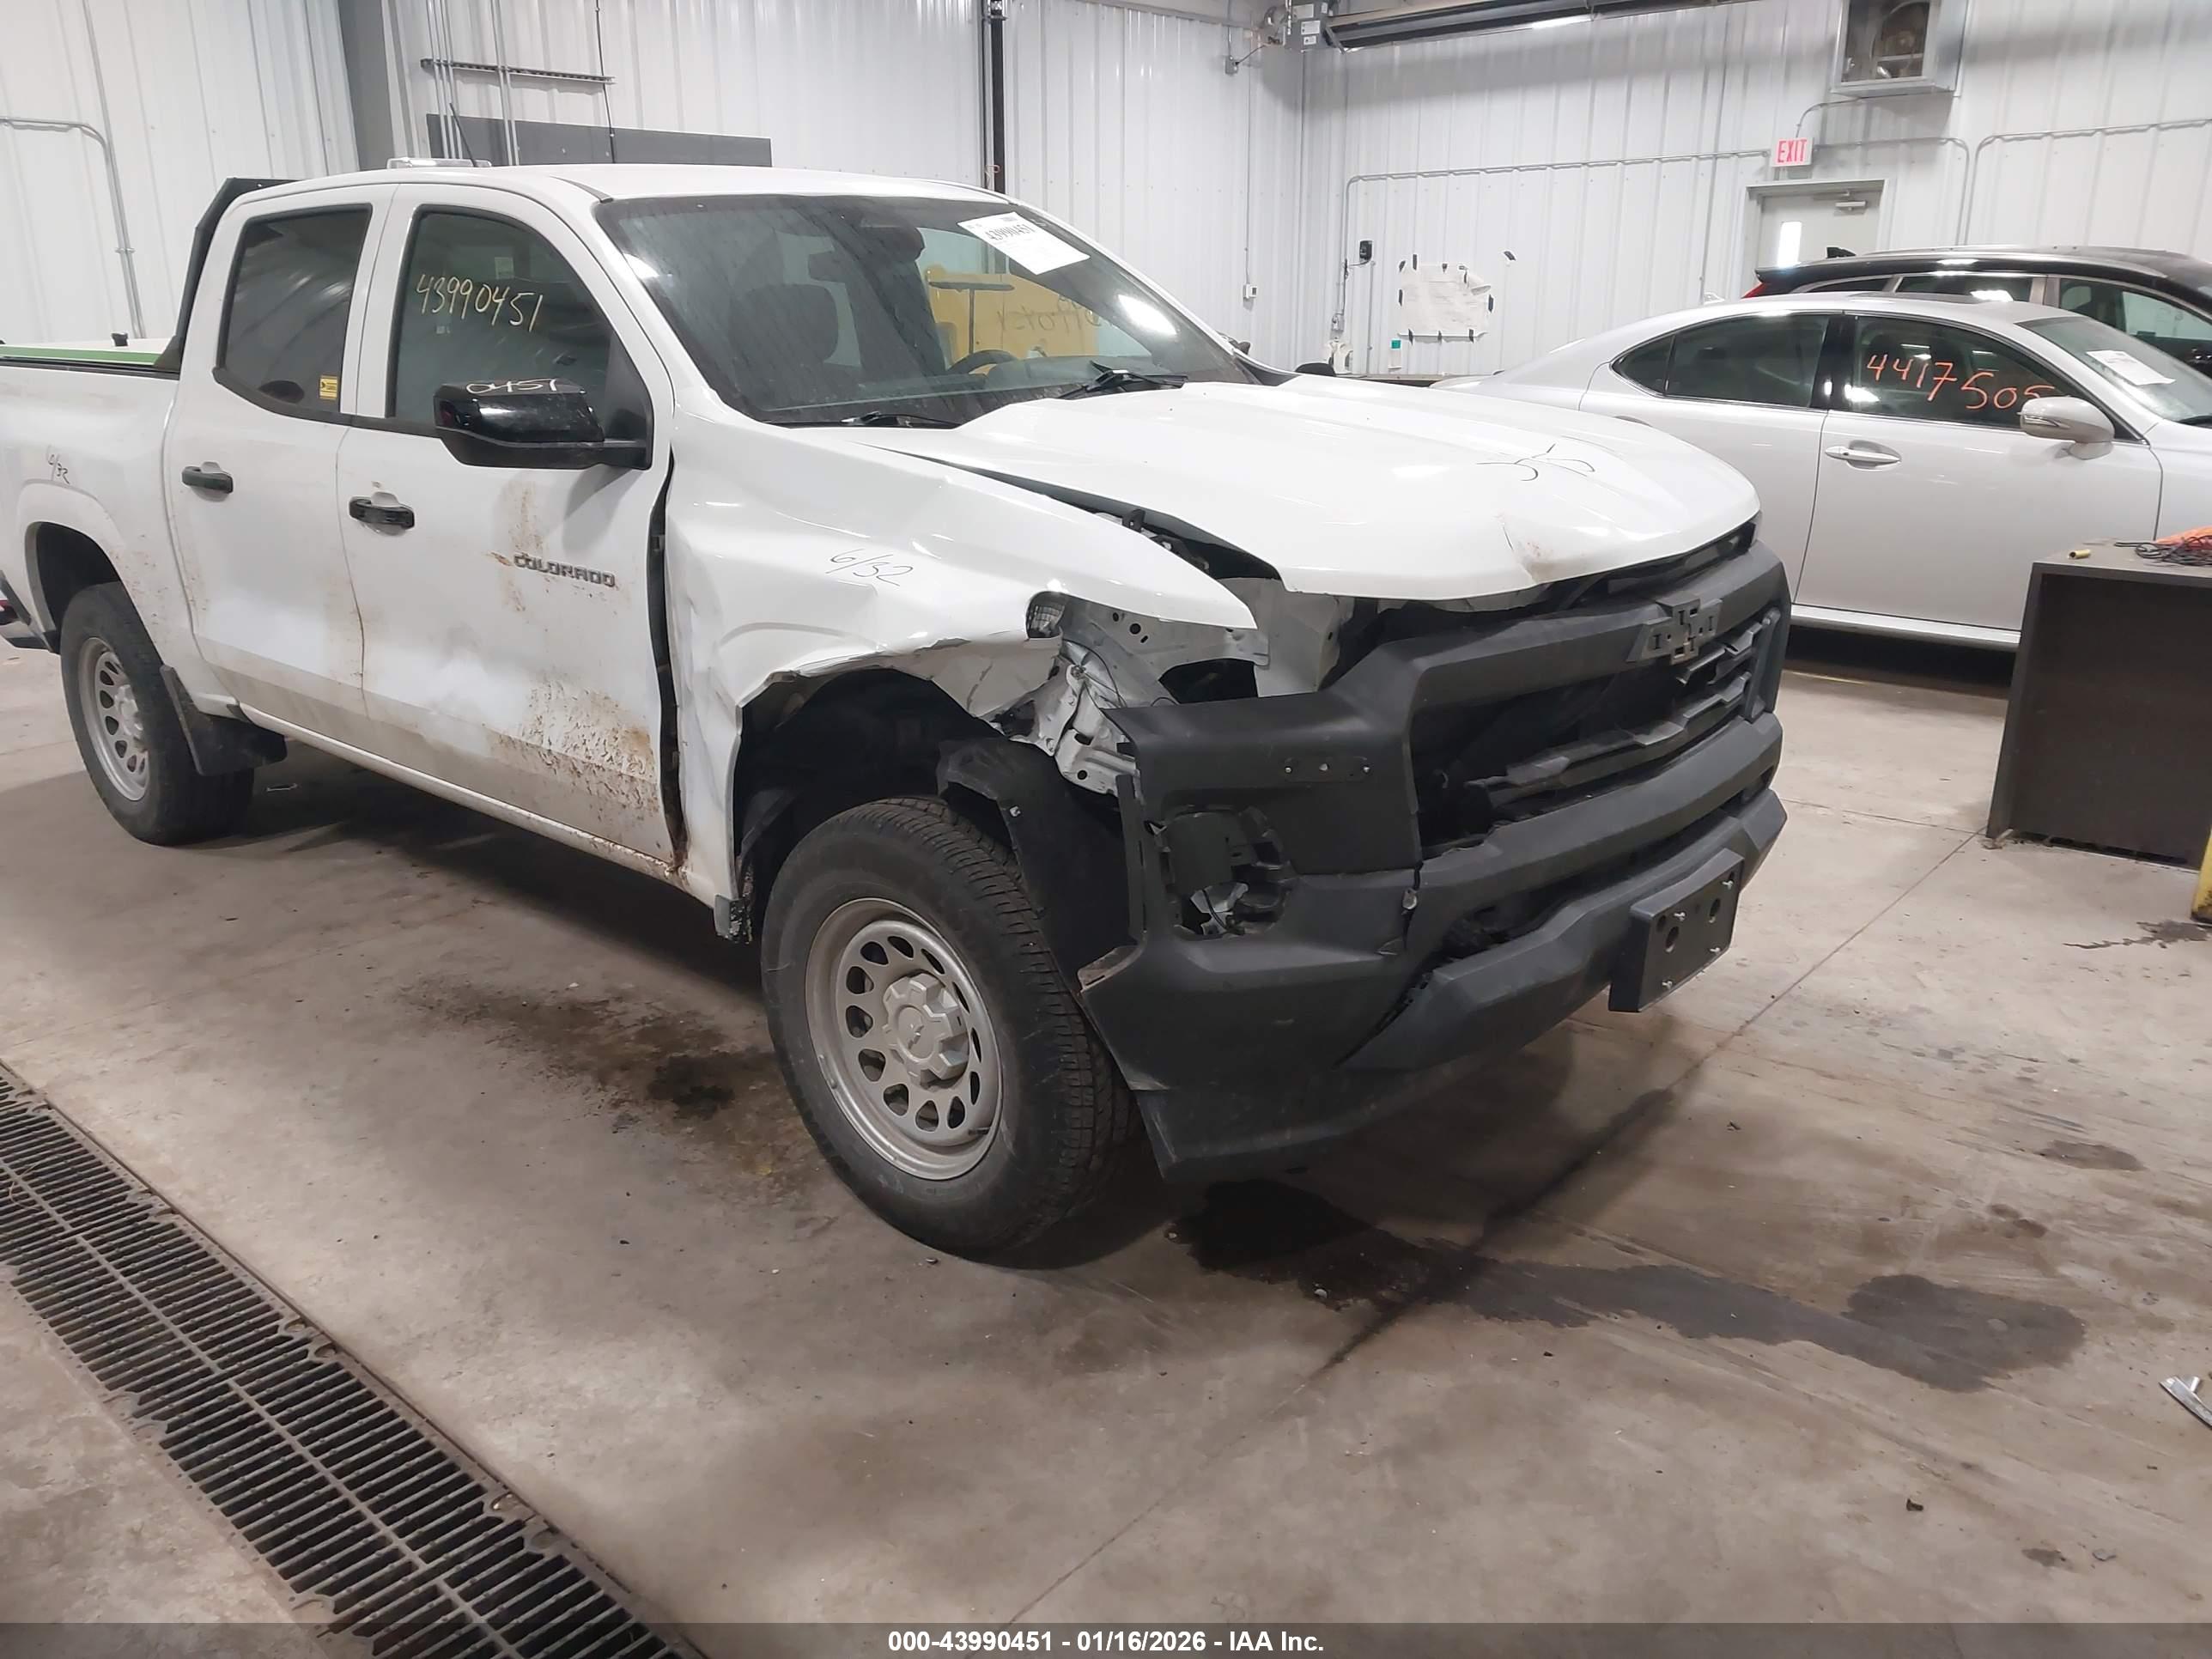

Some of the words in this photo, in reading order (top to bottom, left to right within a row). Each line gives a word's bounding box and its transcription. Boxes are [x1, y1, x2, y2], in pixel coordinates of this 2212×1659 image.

[1778, 139, 1808, 163] EXIT
[416, 274, 544, 333] 43990451
[465, 378, 557, 395] 0451
[514, 553, 616, 587] COLORADO
